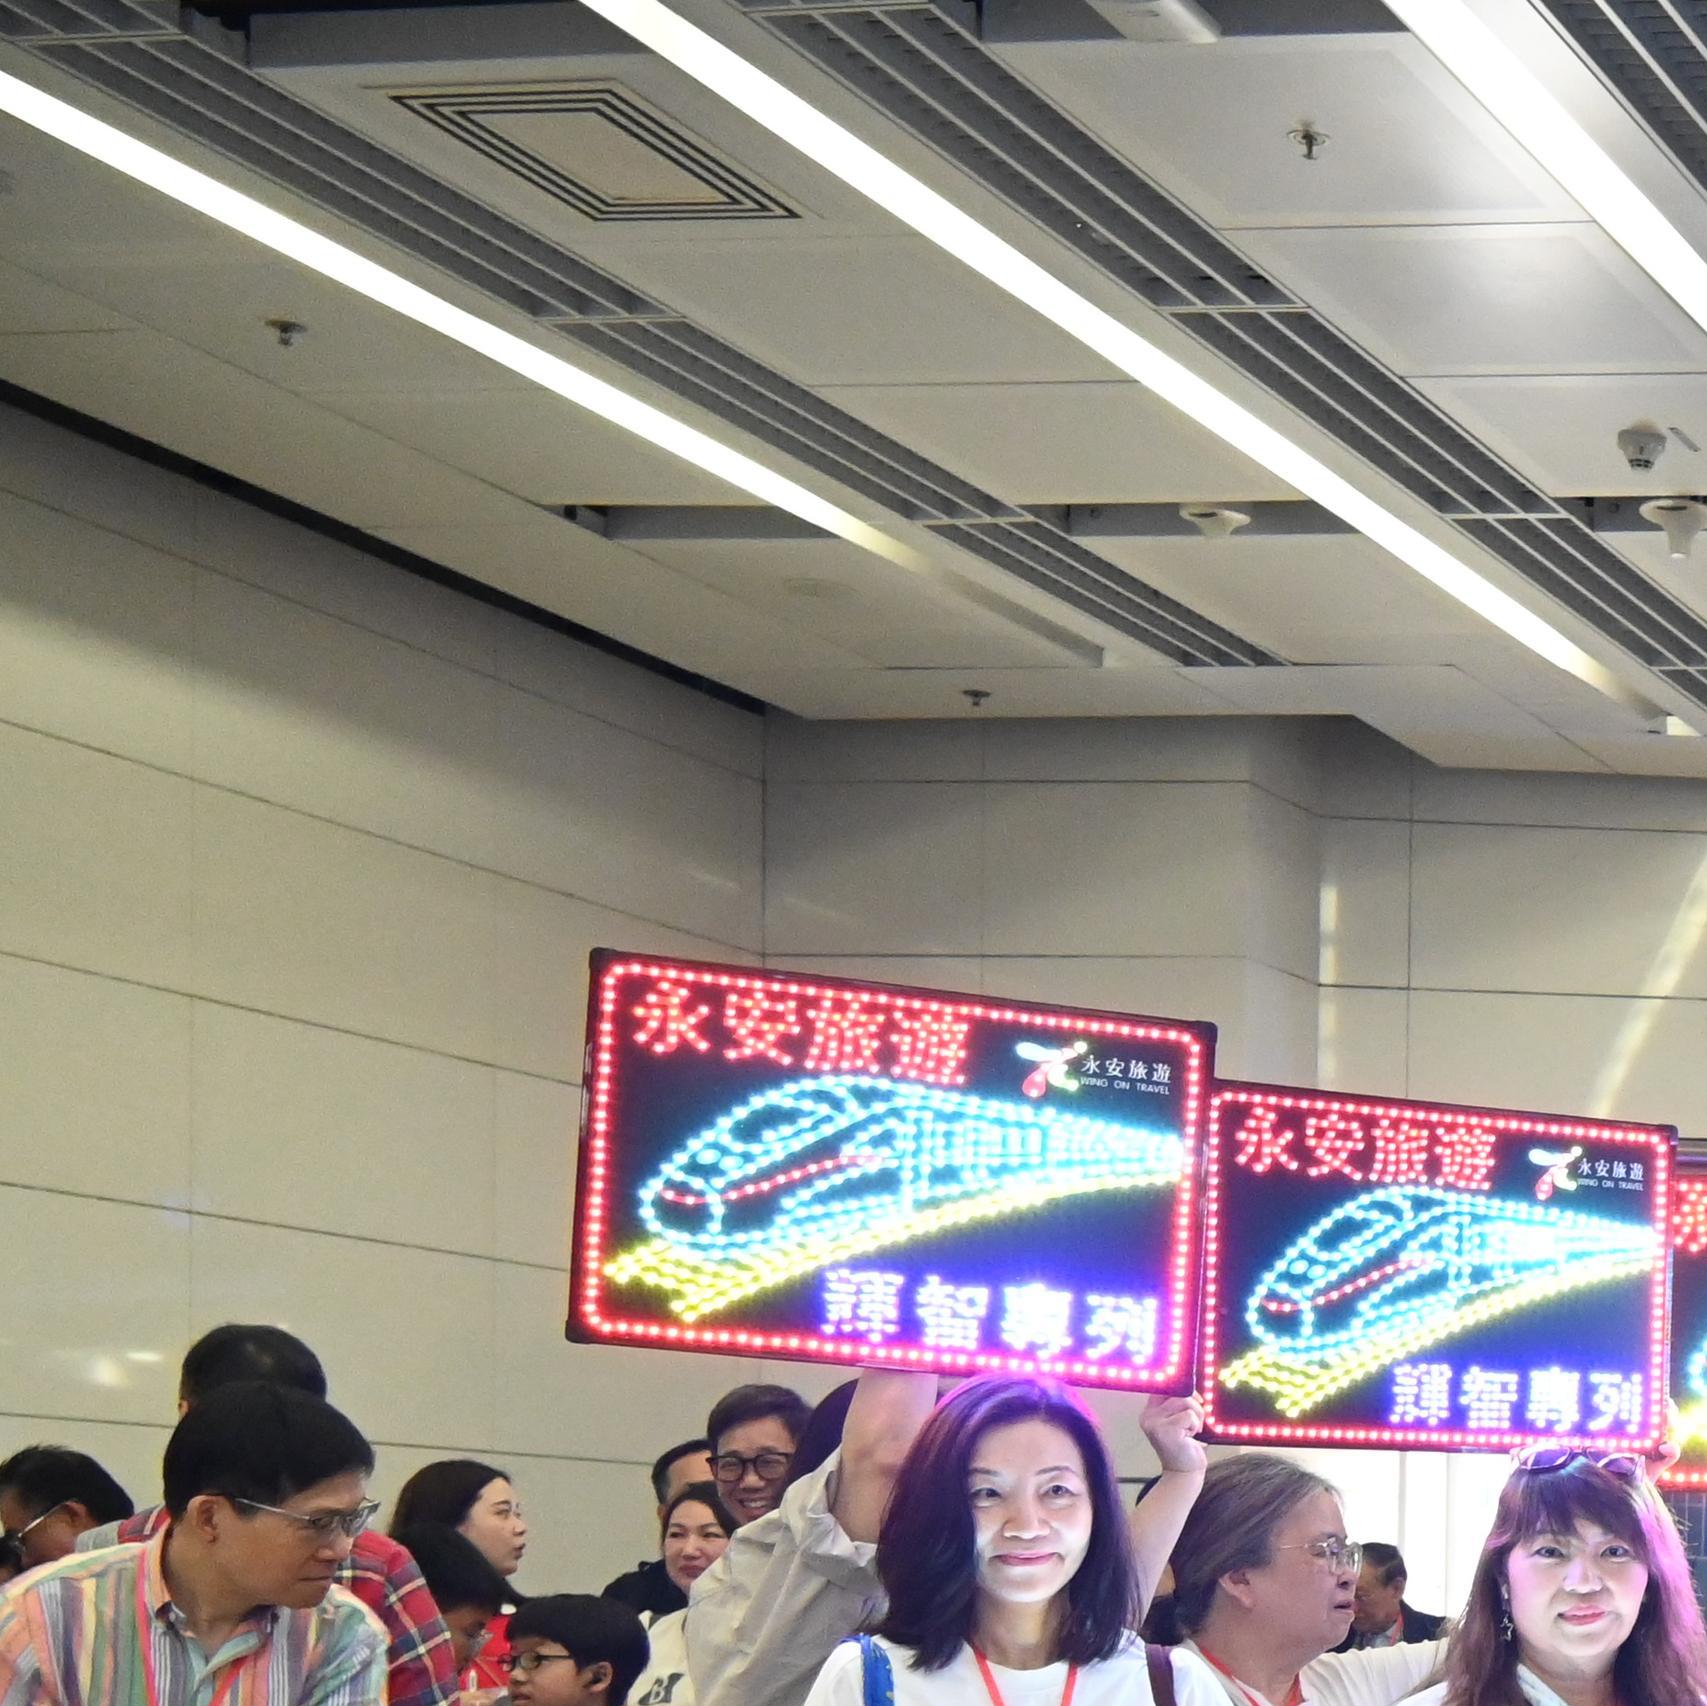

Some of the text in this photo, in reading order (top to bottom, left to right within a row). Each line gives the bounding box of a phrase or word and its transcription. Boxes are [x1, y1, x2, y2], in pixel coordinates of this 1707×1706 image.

[632, 978, 973, 1085] 永安旅遊
[1080, 1053, 1173, 1084] 永安旅遊
[1080, 1076, 1171, 1096] WING ON TRAVEL
[1234, 1107, 1497, 1190] 永安旅遊
[1577, 1158, 1644, 1181] 永安旅遊
[1602, 1180, 1615, 1188] ON
[819, 1268, 1160, 1364] 輝智專列
[1390, 1362, 1643, 1433] 輝智專列
